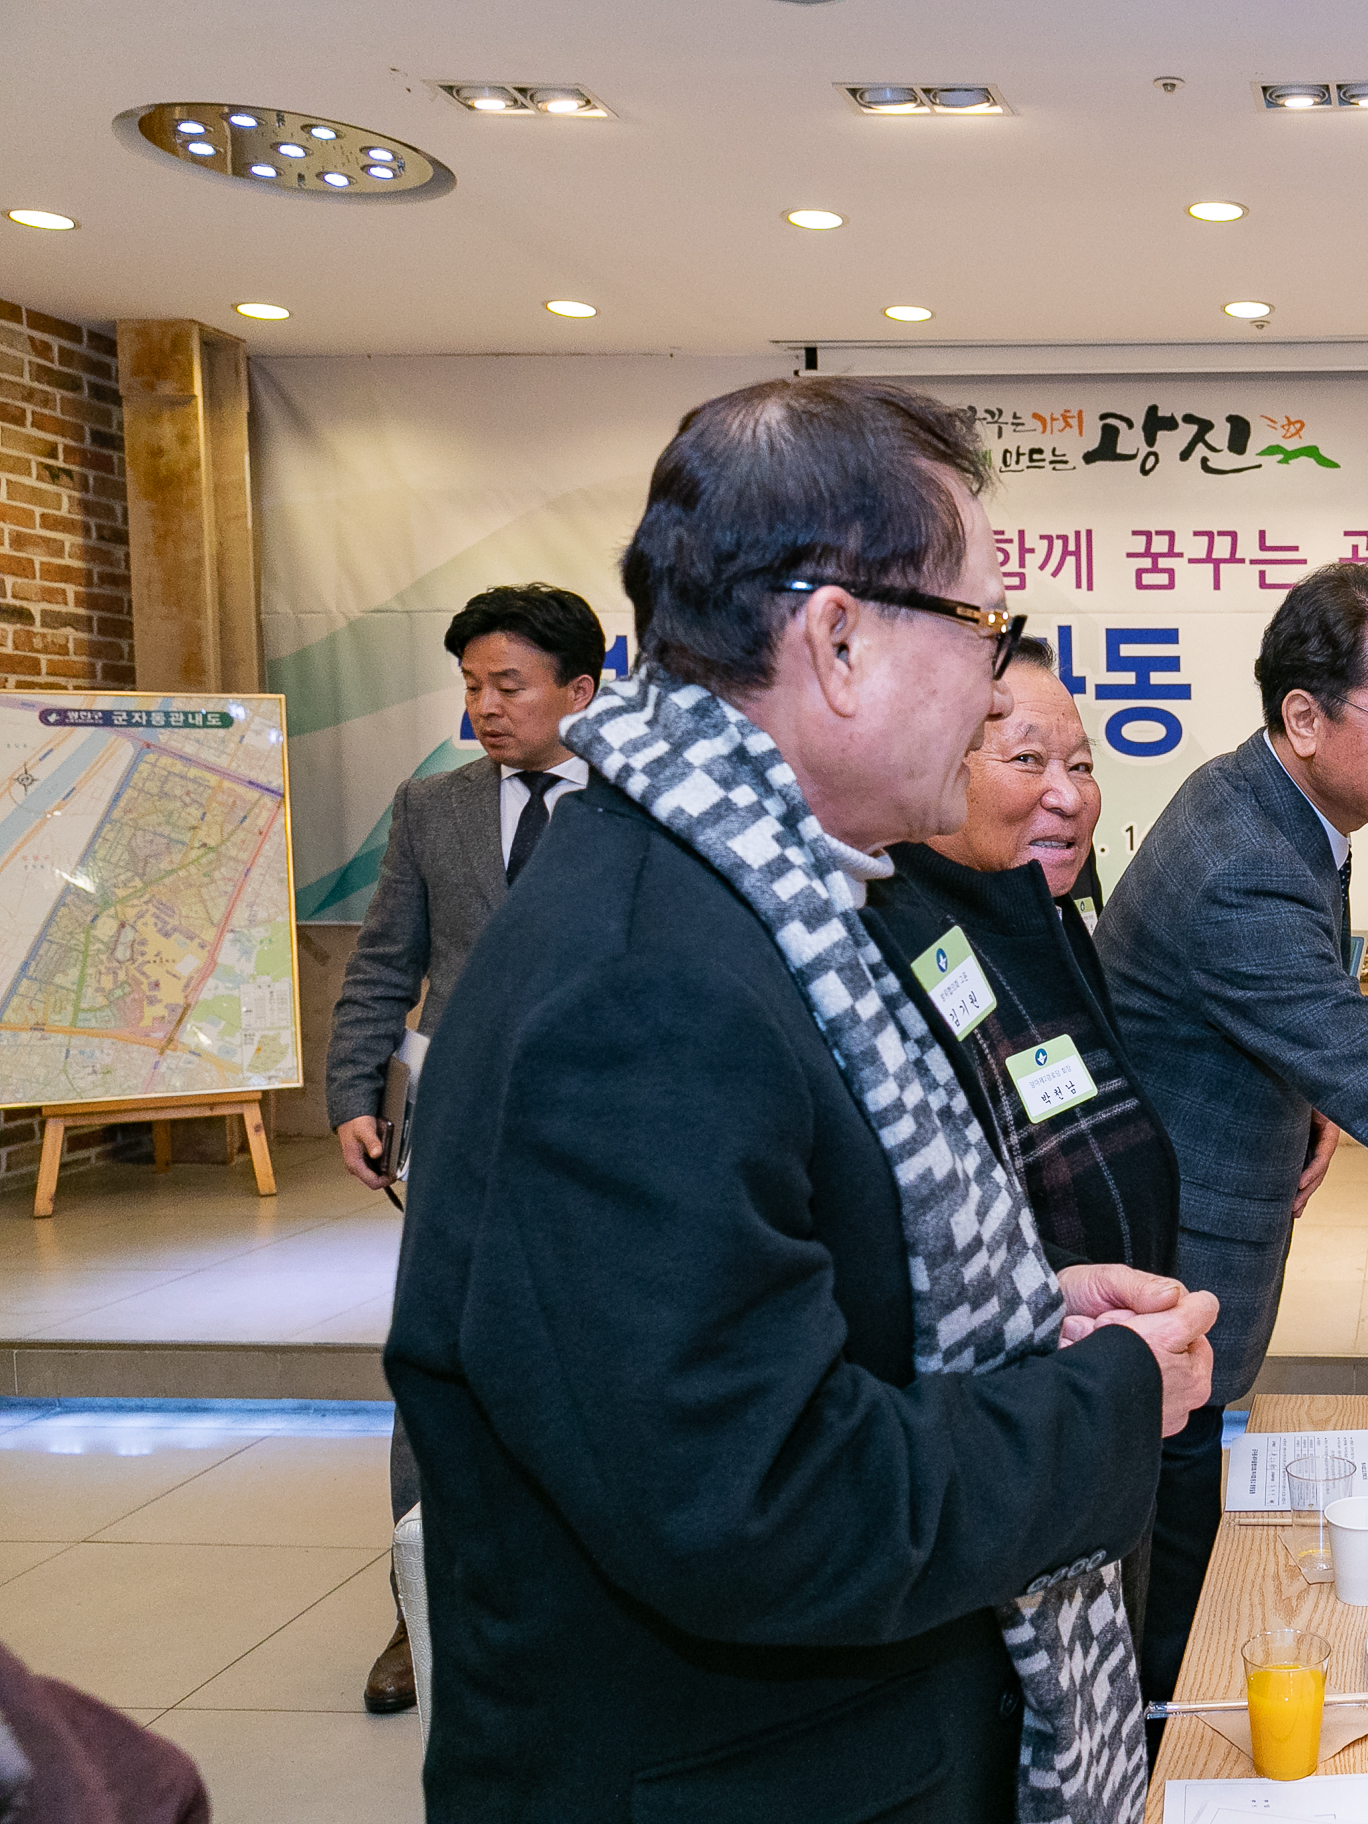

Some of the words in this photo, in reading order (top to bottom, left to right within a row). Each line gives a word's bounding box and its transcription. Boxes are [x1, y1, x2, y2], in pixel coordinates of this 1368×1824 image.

[999, 445, 1077, 473] 만드는
[1082, 403, 1263, 476] 광진
[1031, 409, 1085, 437] 가치
[1125, 528, 1308, 591] 꿈꾸는
